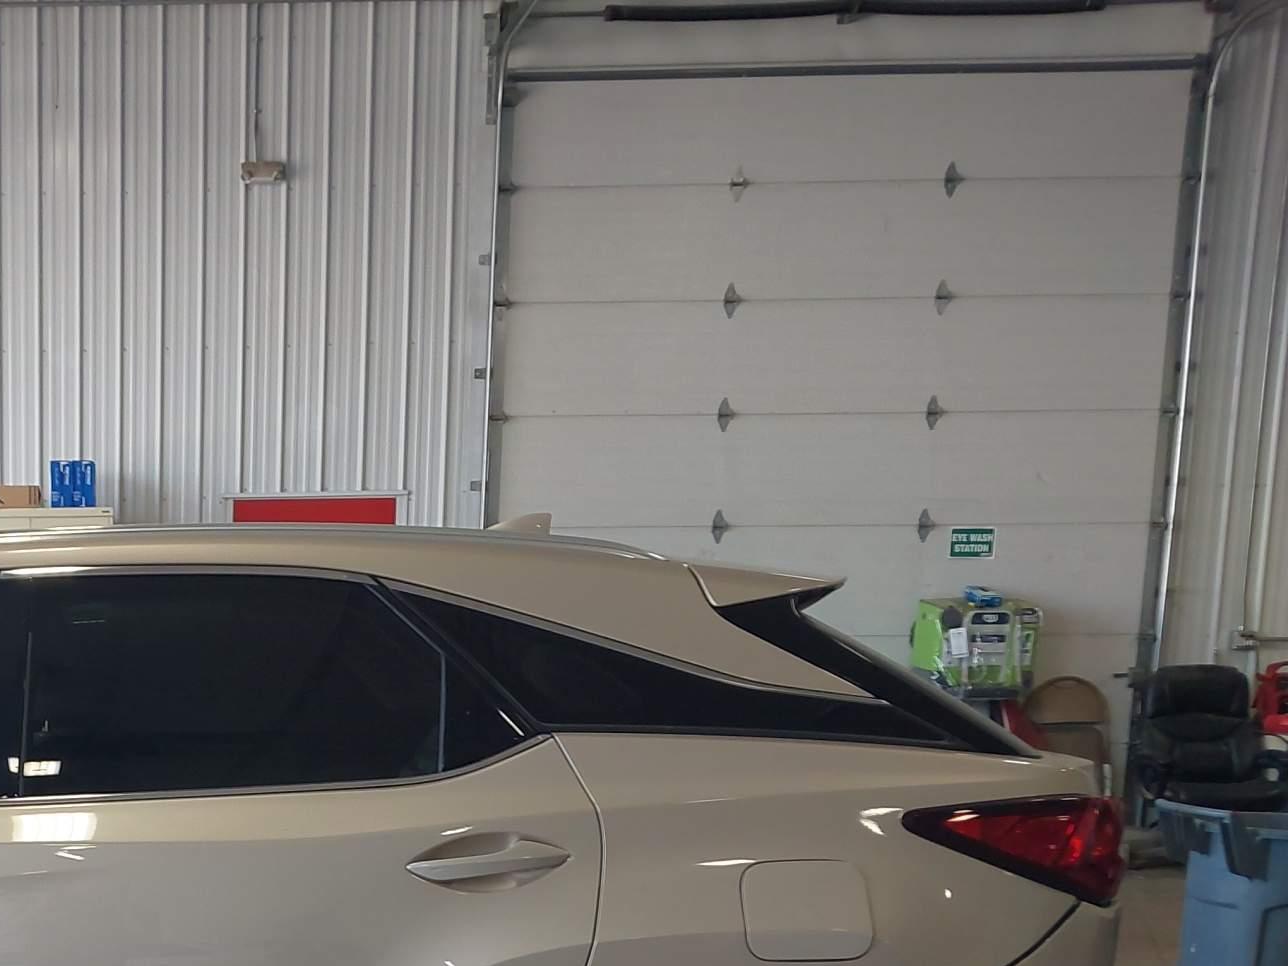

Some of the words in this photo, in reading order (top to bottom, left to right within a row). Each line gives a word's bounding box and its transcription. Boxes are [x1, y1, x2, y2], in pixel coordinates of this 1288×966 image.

[952, 533, 968, 542] EYE
[969, 533, 994, 542] WASH
[954, 544, 990, 553] STATION
